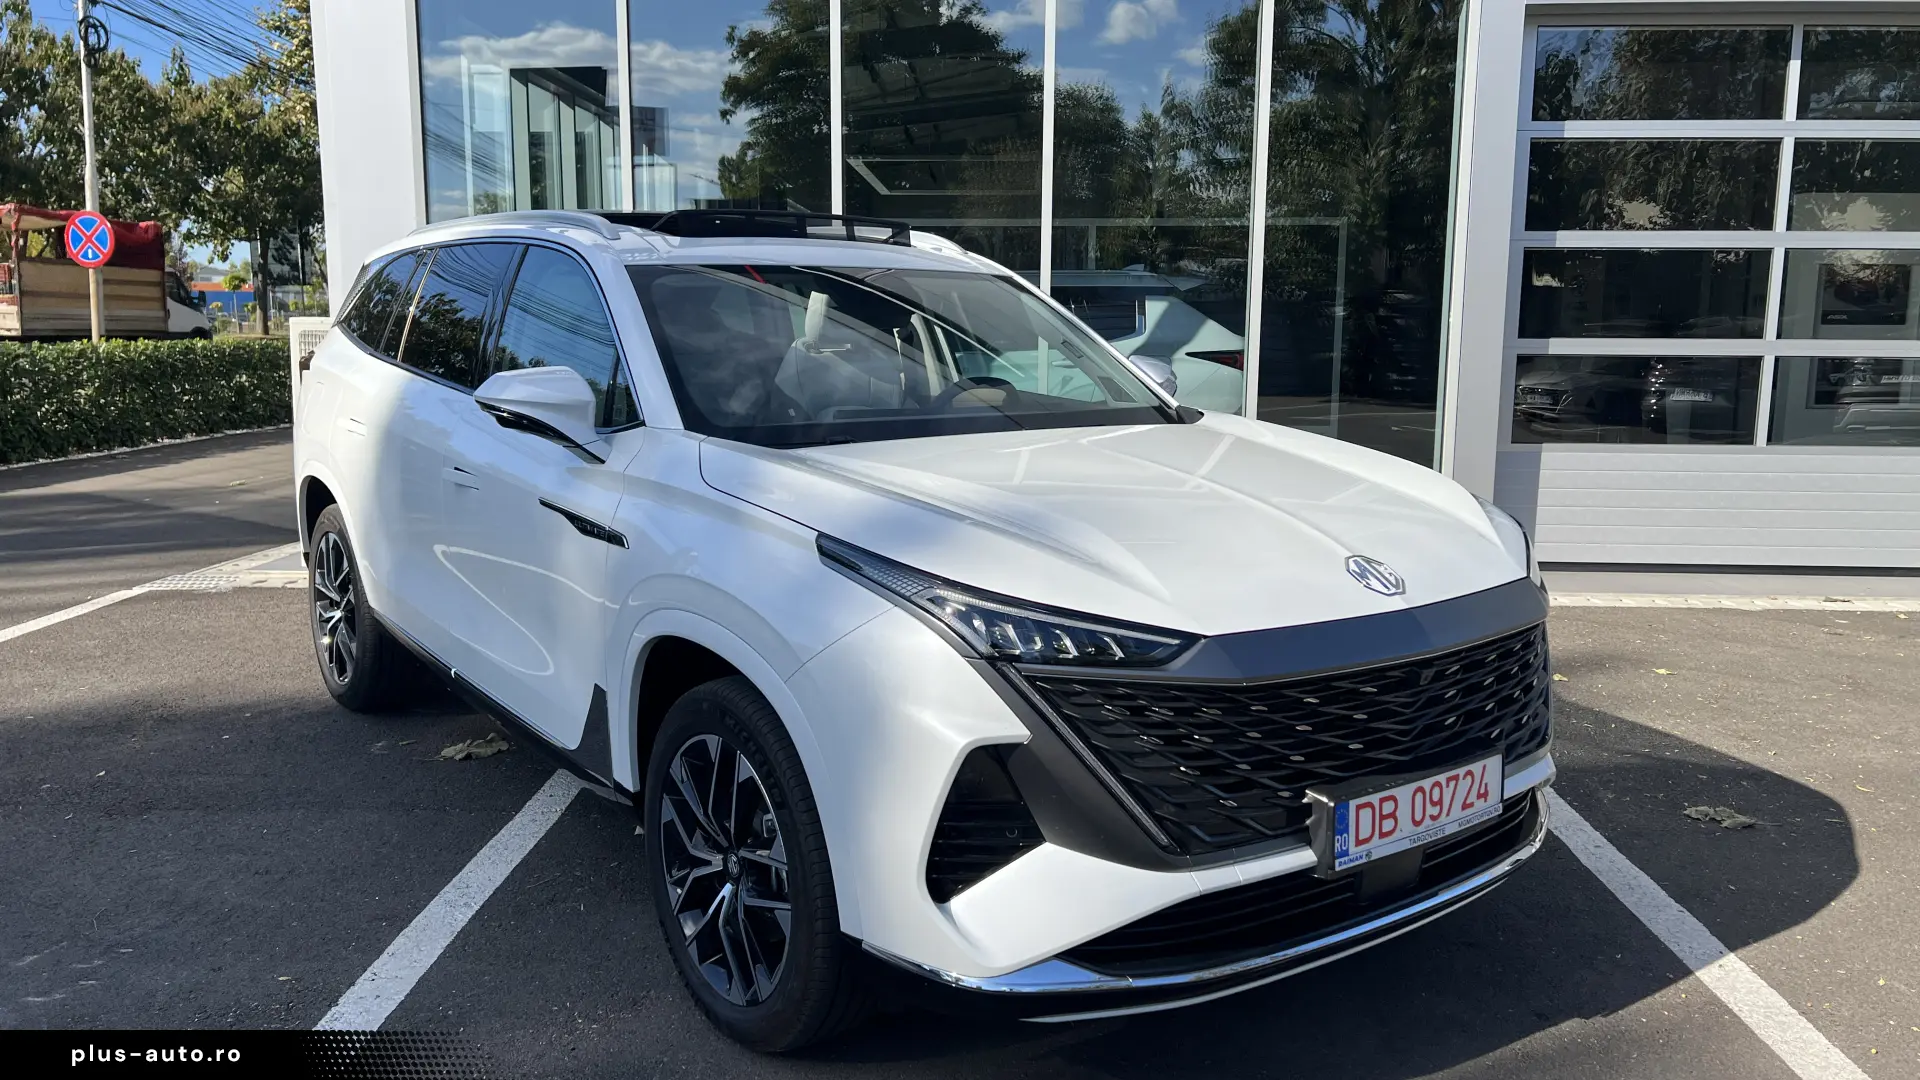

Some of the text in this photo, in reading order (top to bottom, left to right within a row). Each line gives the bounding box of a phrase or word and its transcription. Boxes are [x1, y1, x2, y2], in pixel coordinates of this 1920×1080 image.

[1347, 556, 1404, 595] MG
[1355, 764, 1489, 847] DB 09724
[1335, 833, 1348, 852] RO
[1408, 827, 1446, 846] TARGOVISTE
